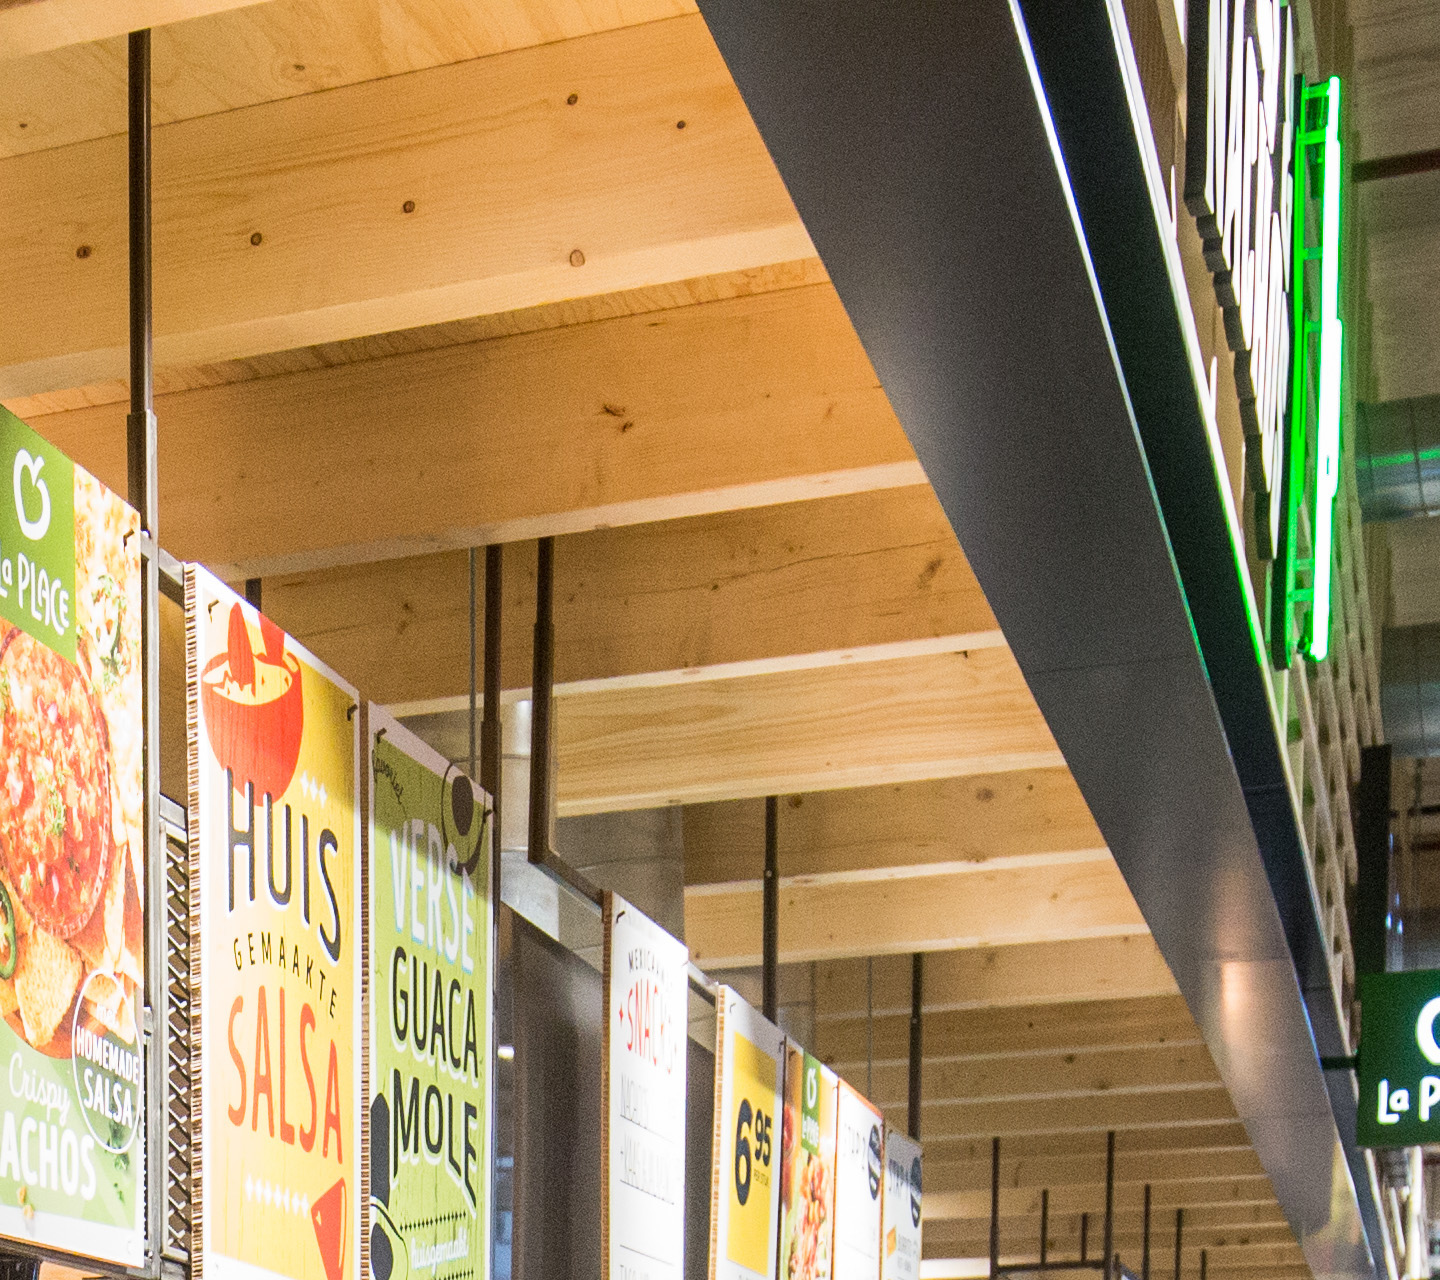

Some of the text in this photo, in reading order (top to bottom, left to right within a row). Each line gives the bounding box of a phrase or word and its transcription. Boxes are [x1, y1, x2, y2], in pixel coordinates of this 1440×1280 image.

[18, 551, 70, 636] PLACE
[225, 765, 342, 967] HUIS
[389, 819, 475, 975] VERSE
[232, 936, 338, 1020] GEMAAKTE
[392, 945, 480, 1080] GUACA
[9, 1051, 71, 1126] Crispy
[75, 1025, 140, 1086] HOMEMADE
[83, 1067, 133, 1129] SALSA
[226, 985, 345, 1164] SALSA
[392, 1068, 478, 1211] MOLE
[1377, 1079, 1410, 1124] La
